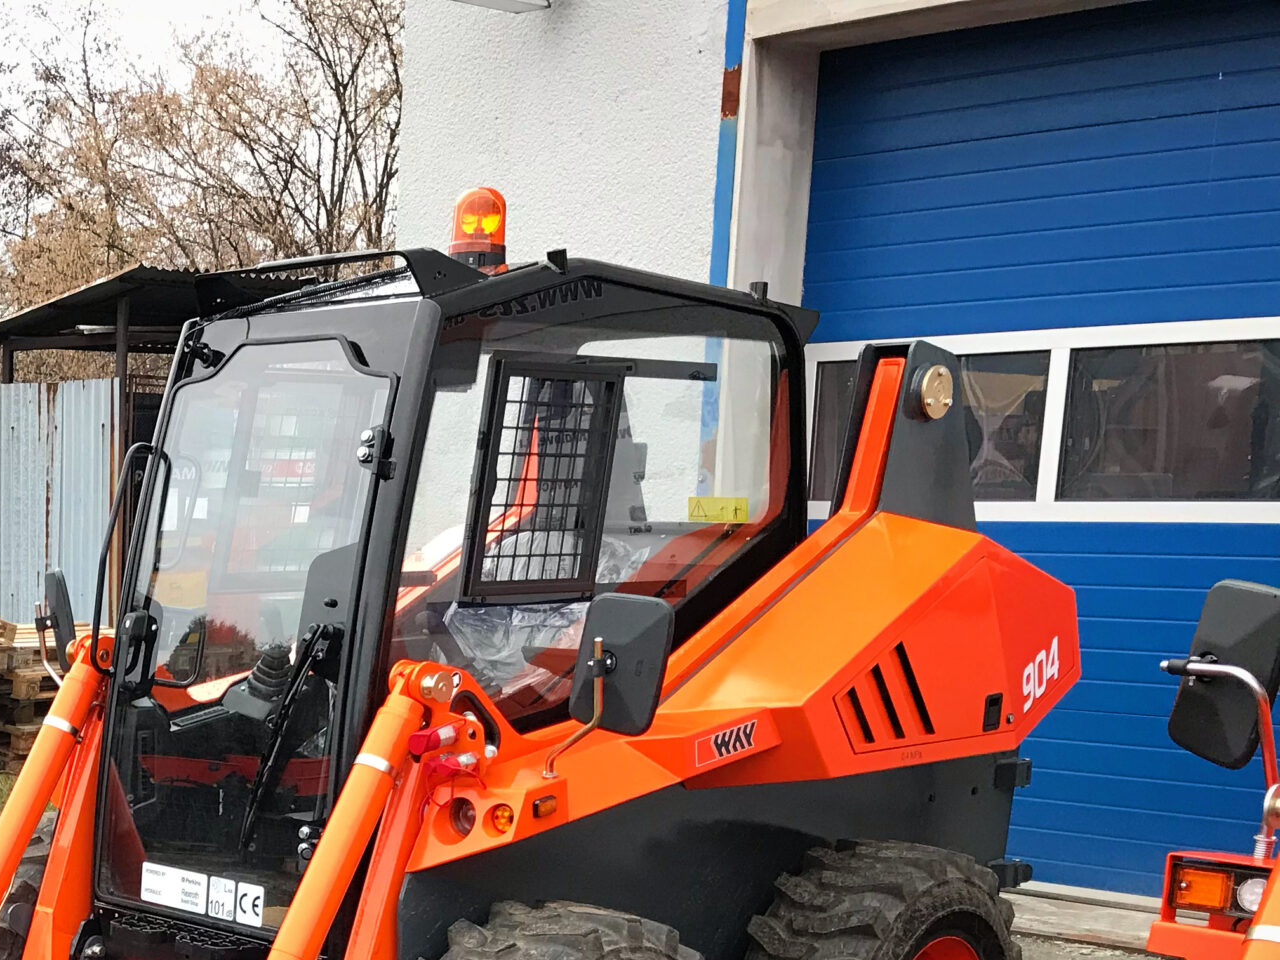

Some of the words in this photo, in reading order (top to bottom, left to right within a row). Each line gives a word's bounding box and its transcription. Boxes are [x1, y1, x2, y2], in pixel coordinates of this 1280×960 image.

[1022, 635, 1060, 714] 904
[712, 720, 757, 758] WAY
[209, 899, 224, 917] 101
[239, 893, 260, 917] CE
